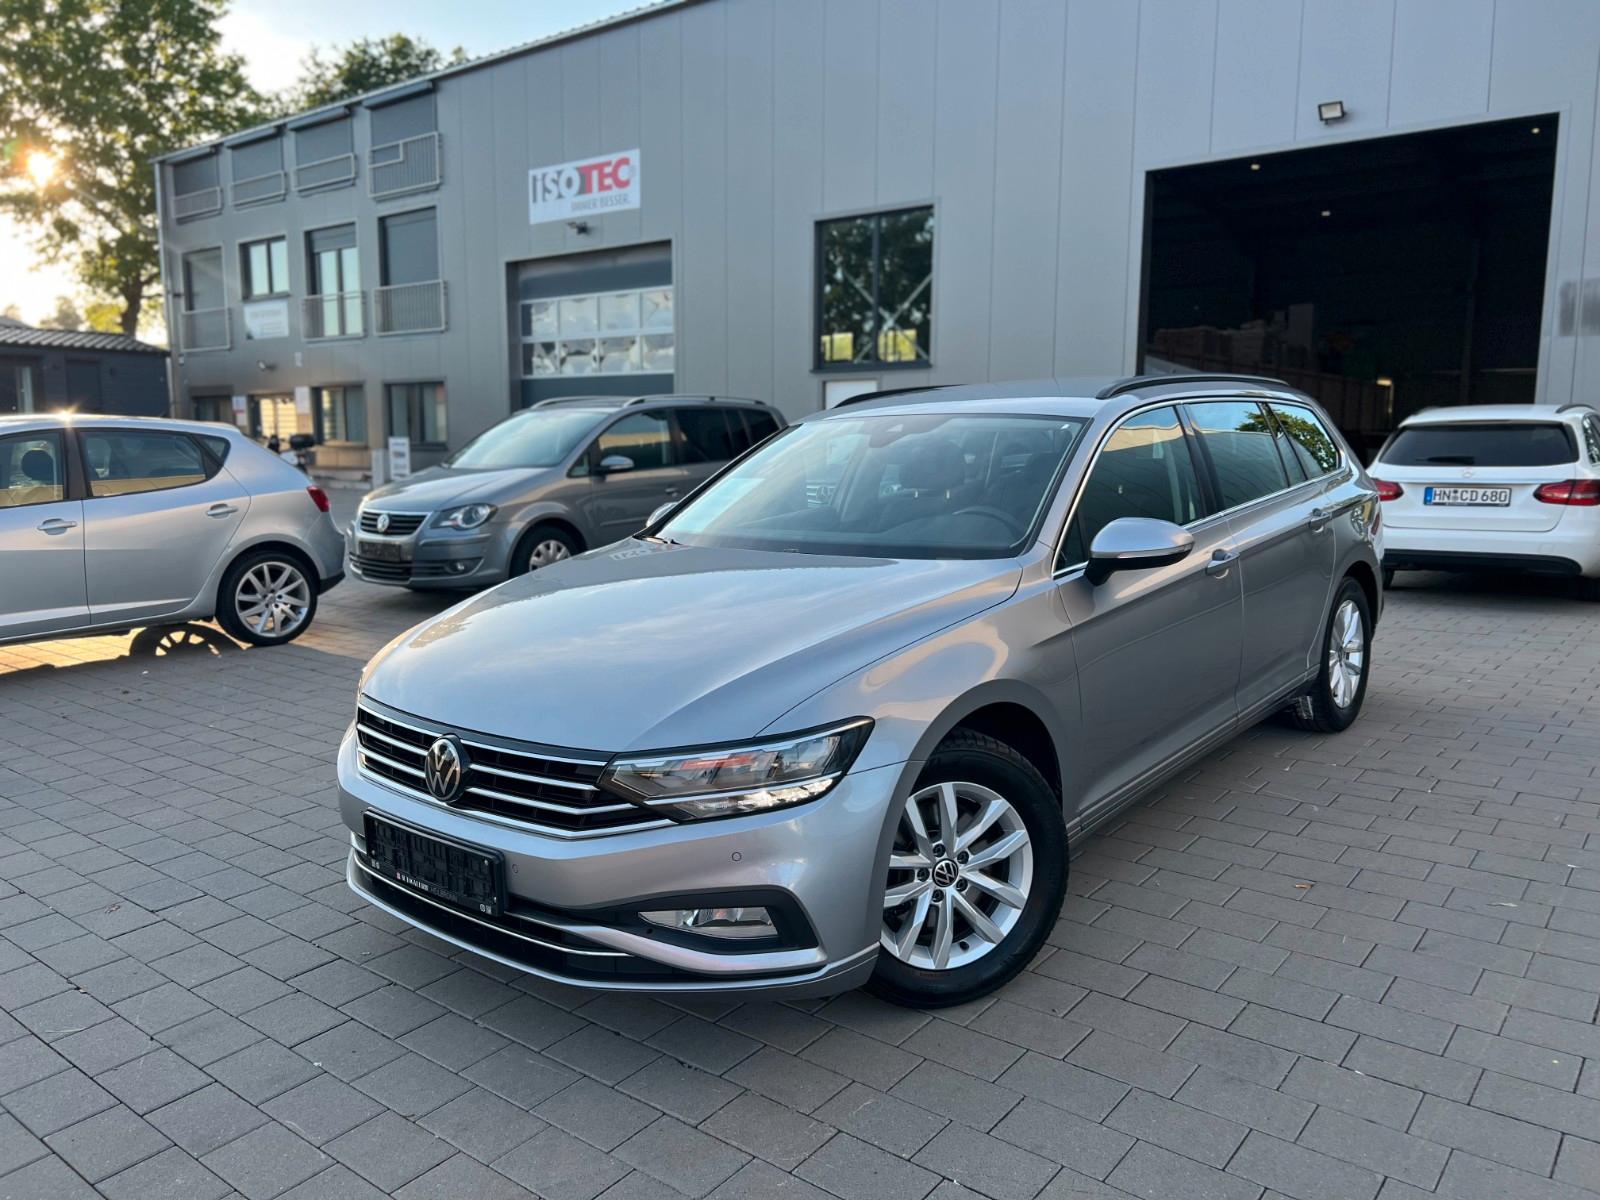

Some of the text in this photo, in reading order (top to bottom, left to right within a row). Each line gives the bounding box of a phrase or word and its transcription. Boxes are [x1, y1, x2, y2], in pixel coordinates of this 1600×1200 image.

[532, 156, 632, 203] ISOTEC
[1433, 490, 1508, 503] HN CD 680
